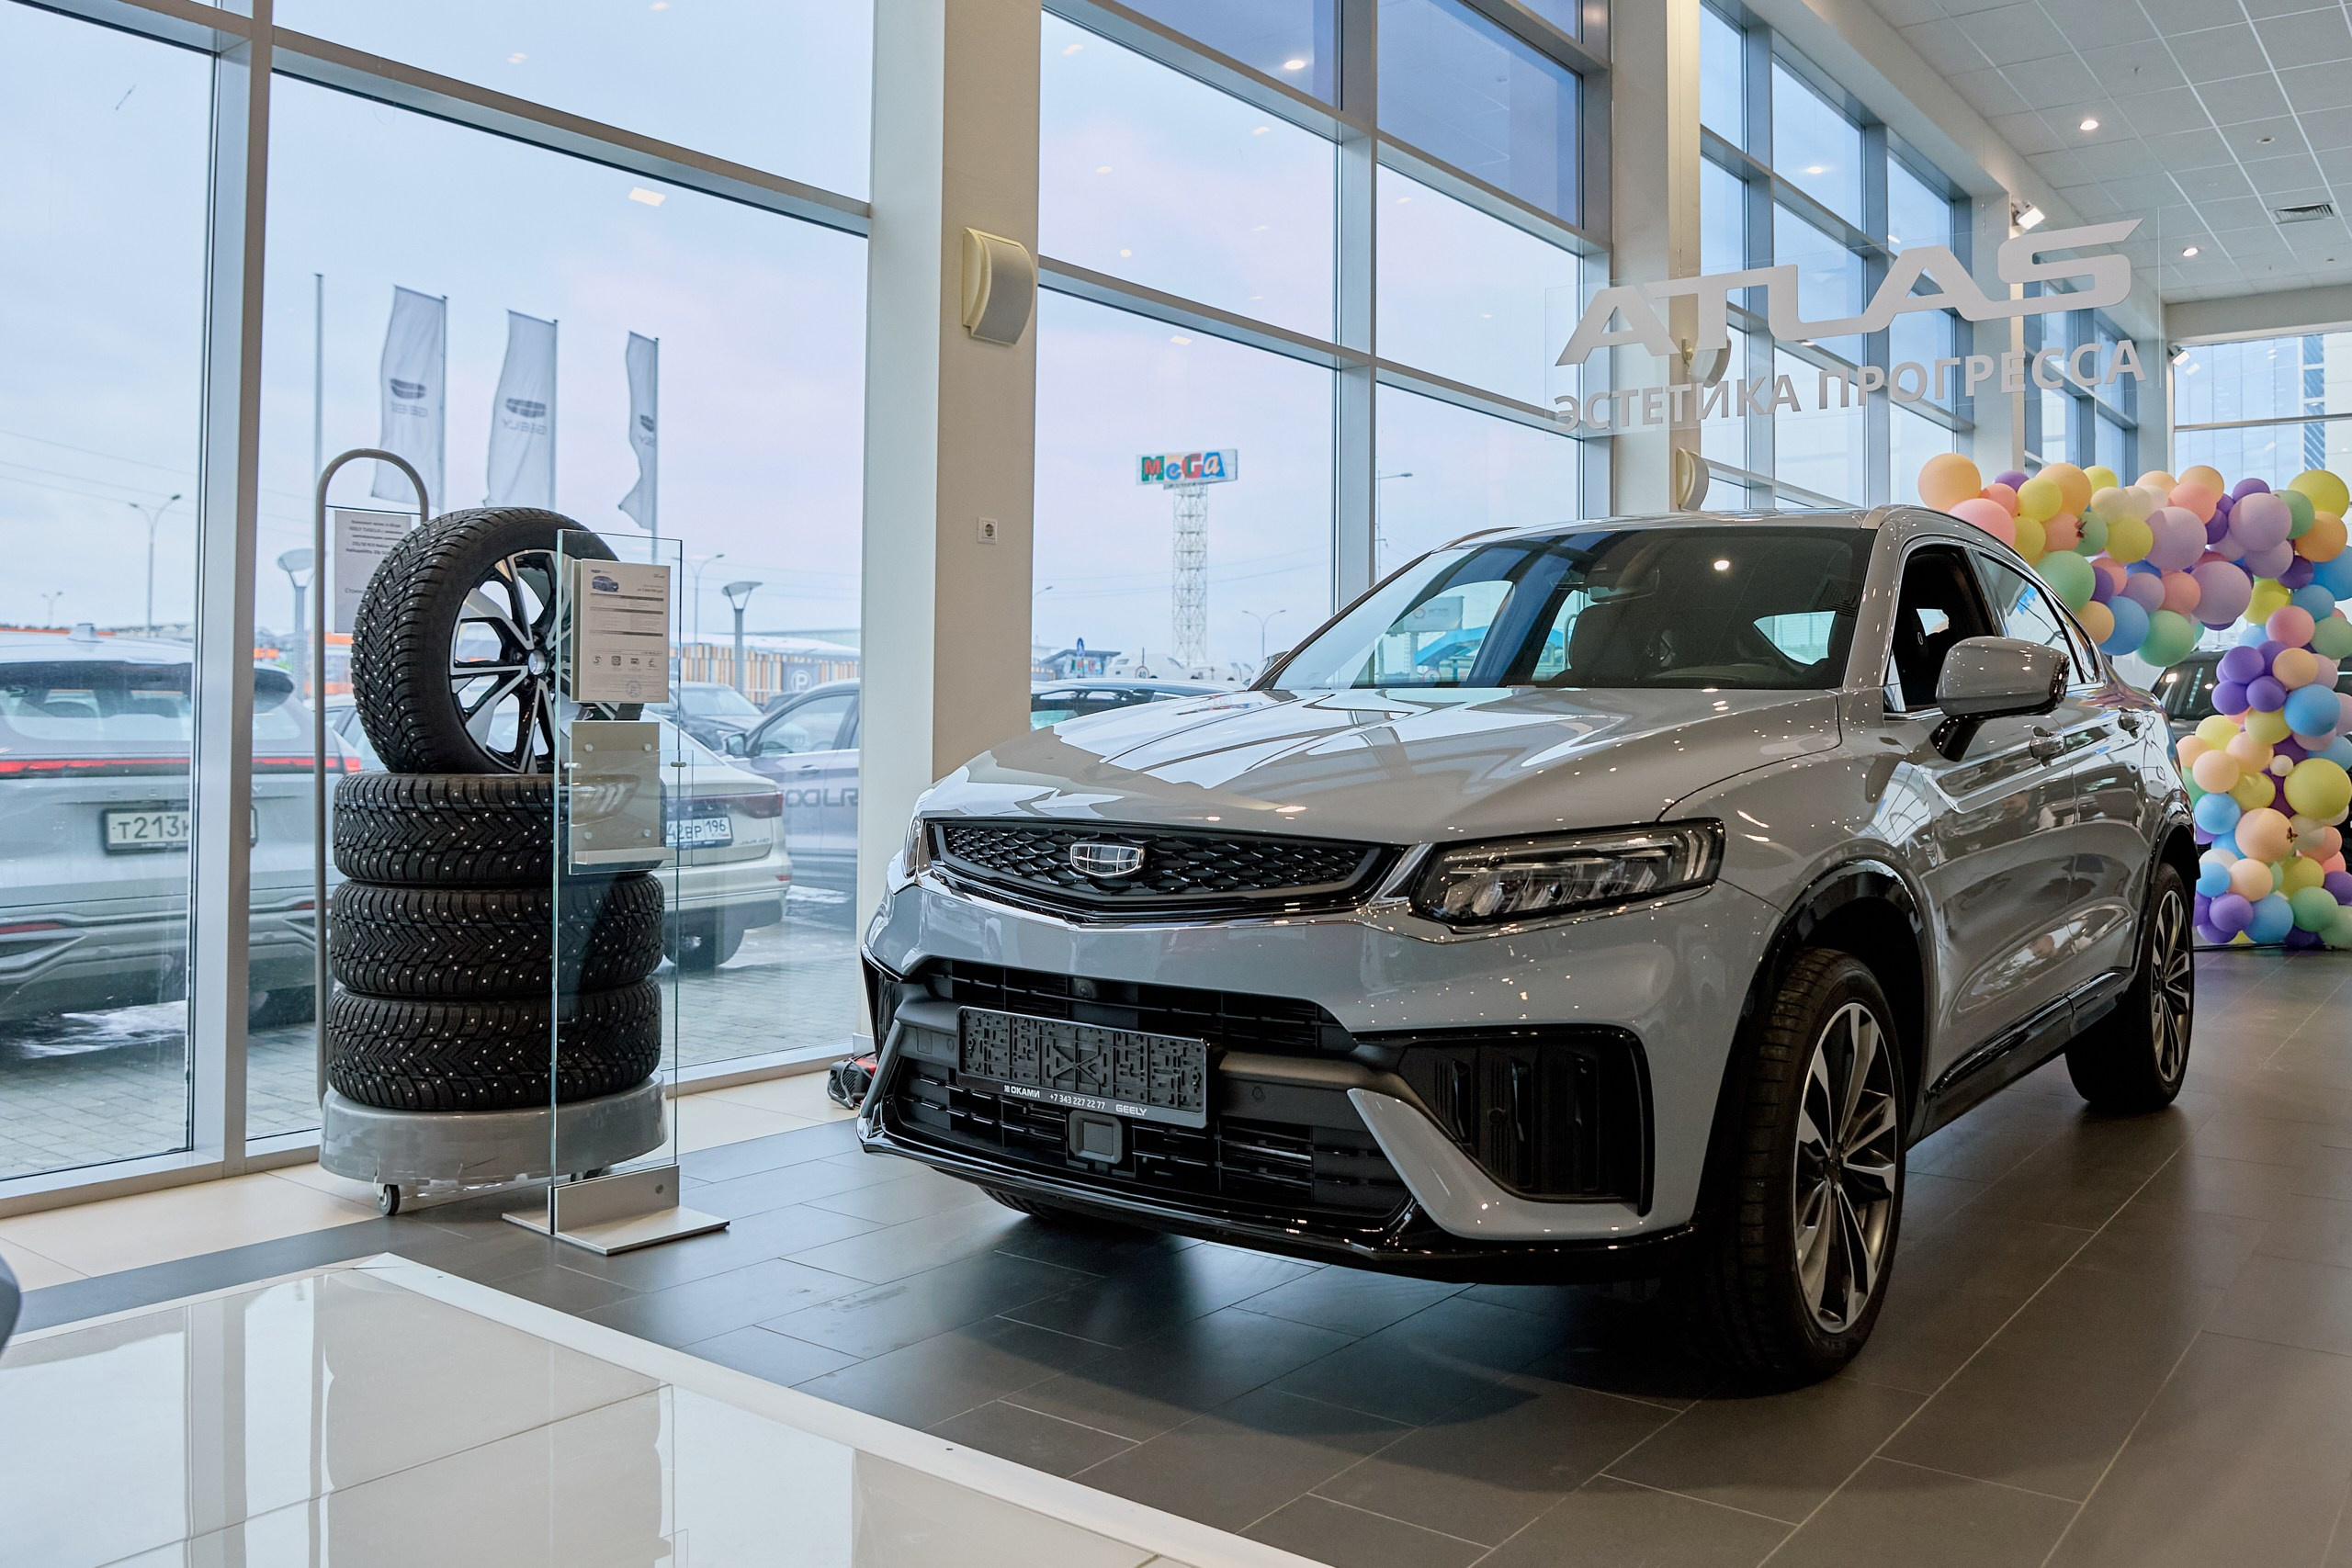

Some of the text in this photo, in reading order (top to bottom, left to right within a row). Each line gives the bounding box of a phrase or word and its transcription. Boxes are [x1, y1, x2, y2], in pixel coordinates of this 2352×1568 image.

[1555, 218, 2144, 367] ATLAS
[1554, 339, 2147, 432] ЭСТЕТИКА ПРОГРЕССА
[705, 818, 727, 833] 196
[1011, 1086, 1148, 1116] ОКАМИ +7 343 227 22 77 GEELY
